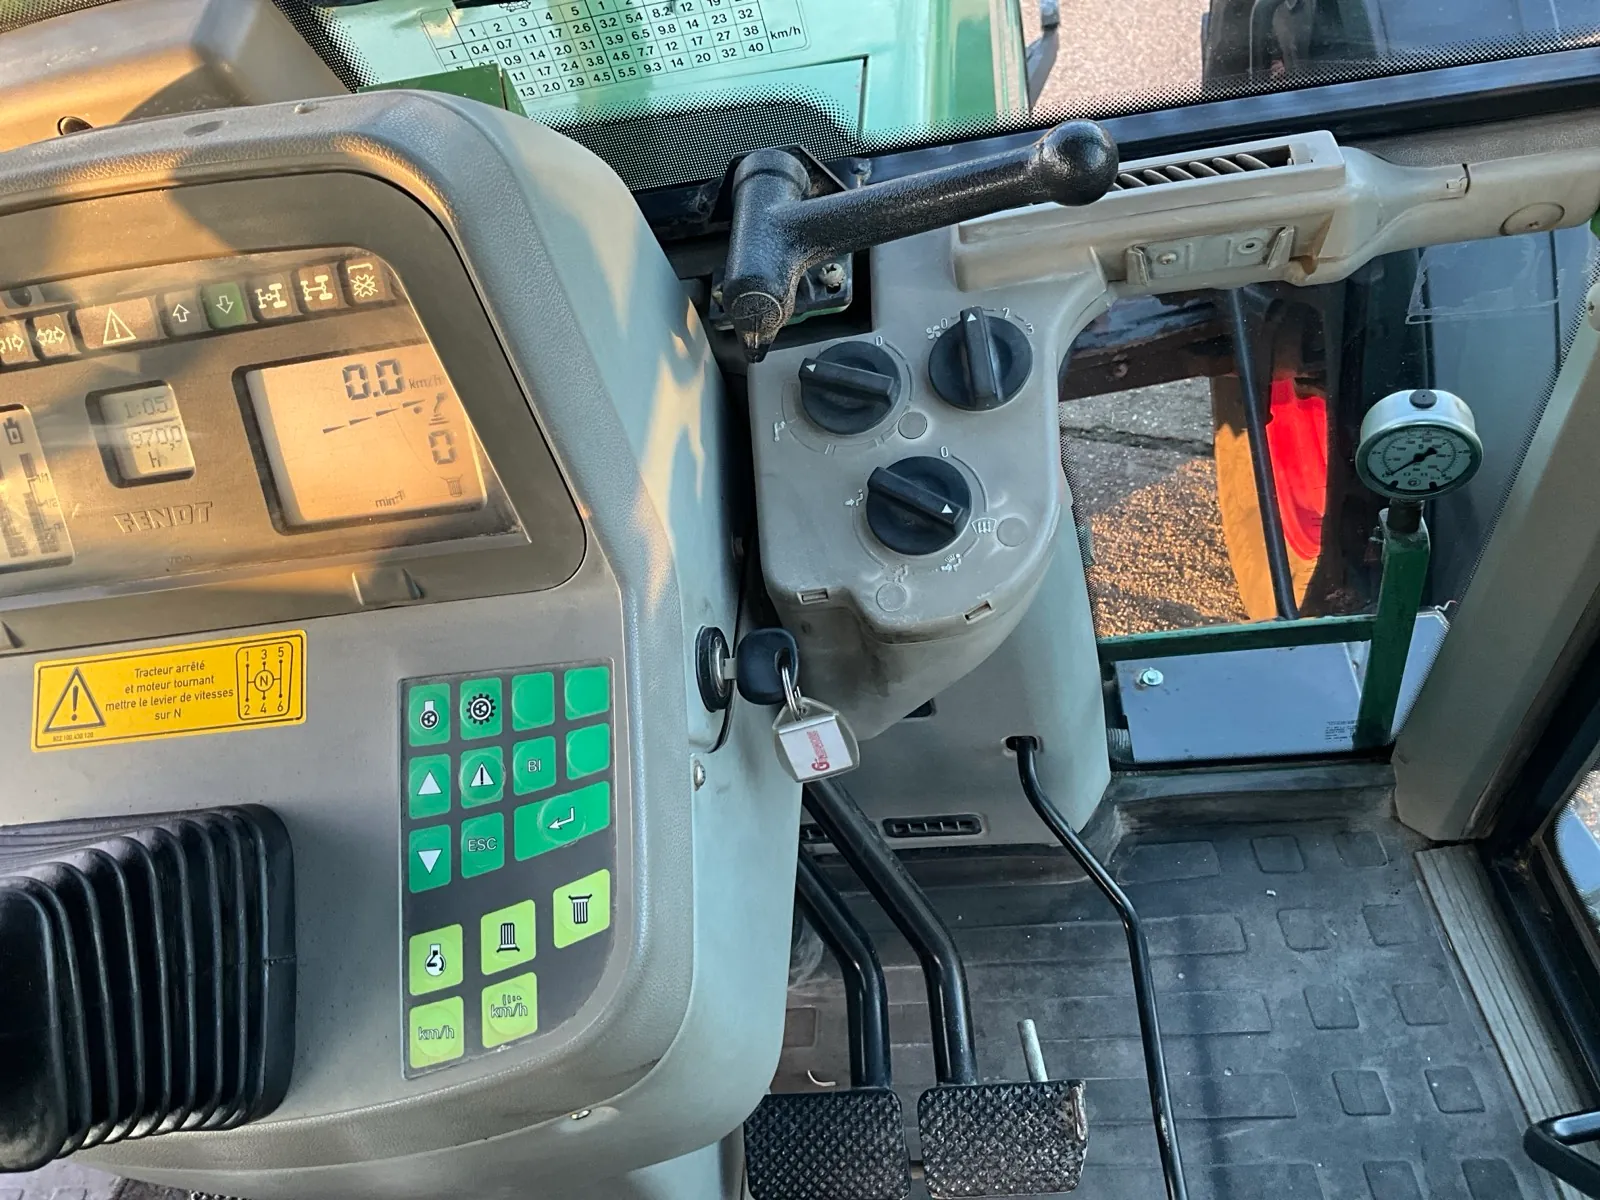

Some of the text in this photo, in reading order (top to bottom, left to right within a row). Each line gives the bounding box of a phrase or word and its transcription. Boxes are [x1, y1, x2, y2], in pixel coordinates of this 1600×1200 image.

[469, 28, 476, 37] 1
[493, 23, 502, 33] 2
[518, 17, 528, 27] 3
[545, 12, 553, 21] 4
[571, 6, 580, 16] 5
[471, 44, 489, 55] 0.4
[496, 39, 512, 50] 0.7
[523, 34, 537, 44] 1.1
[549, 29, 563, 40] 1.7
[573, 23, 591, 34] 2.6
[600, 17, 618, 29] 3.2
[625, 12, 643, 24] 5.4
[652, 6, 670, 18] 8.2
[680, 2, 694, 12] 12
[504, 55, 522, 66] 0.9
[529, 50, 546, 60] 1.4
[554, 45, 572, 56] 2.0
[579, 40, 596, 51] 3.1
[605, 34, 624, 46] 3.9
[631, 29, 650, 41] 6.5
[658, 24, 676, 35] 9.8
[686, 19, 699, 30] 14
[711, 14, 728, 25] 23
[738, 8, 754, 19] 32
[770, 26, 801, 40] km/h
[512, 25, 759, 81] 1.1 1.7 2.4 3.8 4.6 7.7 12 17 27 38
[520, 42, 764, 97] 1.3 2.0 2.9 4.5 5.5 9.3 14 20 32 40
[941, 307, 1035, 335] 0 2 3
[874, 335, 883, 347] 0
[342, 358, 405, 400] 0.0
[124, 396, 168, 418] 1:05
[428, 429, 457, 465] 0
[940, 445, 948, 458] 0
[113, 500, 213, 534] FENDT
[245, 647, 284, 661] 1 3 5
[135, 660, 205, 679] Tracteur arrêté
[125, 675, 214, 694] et moteur tournant
[260, 675, 268, 687] N
[106, 689, 234, 711] mettre le levier de vitesses
[244, 701, 284, 715] 2 4 6
[155, 709, 182, 720] sur N
[468, 838, 497, 852] ESC
[490, 1003, 528, 1017] km/h
[418, 1025, 455, 1040] km/h
